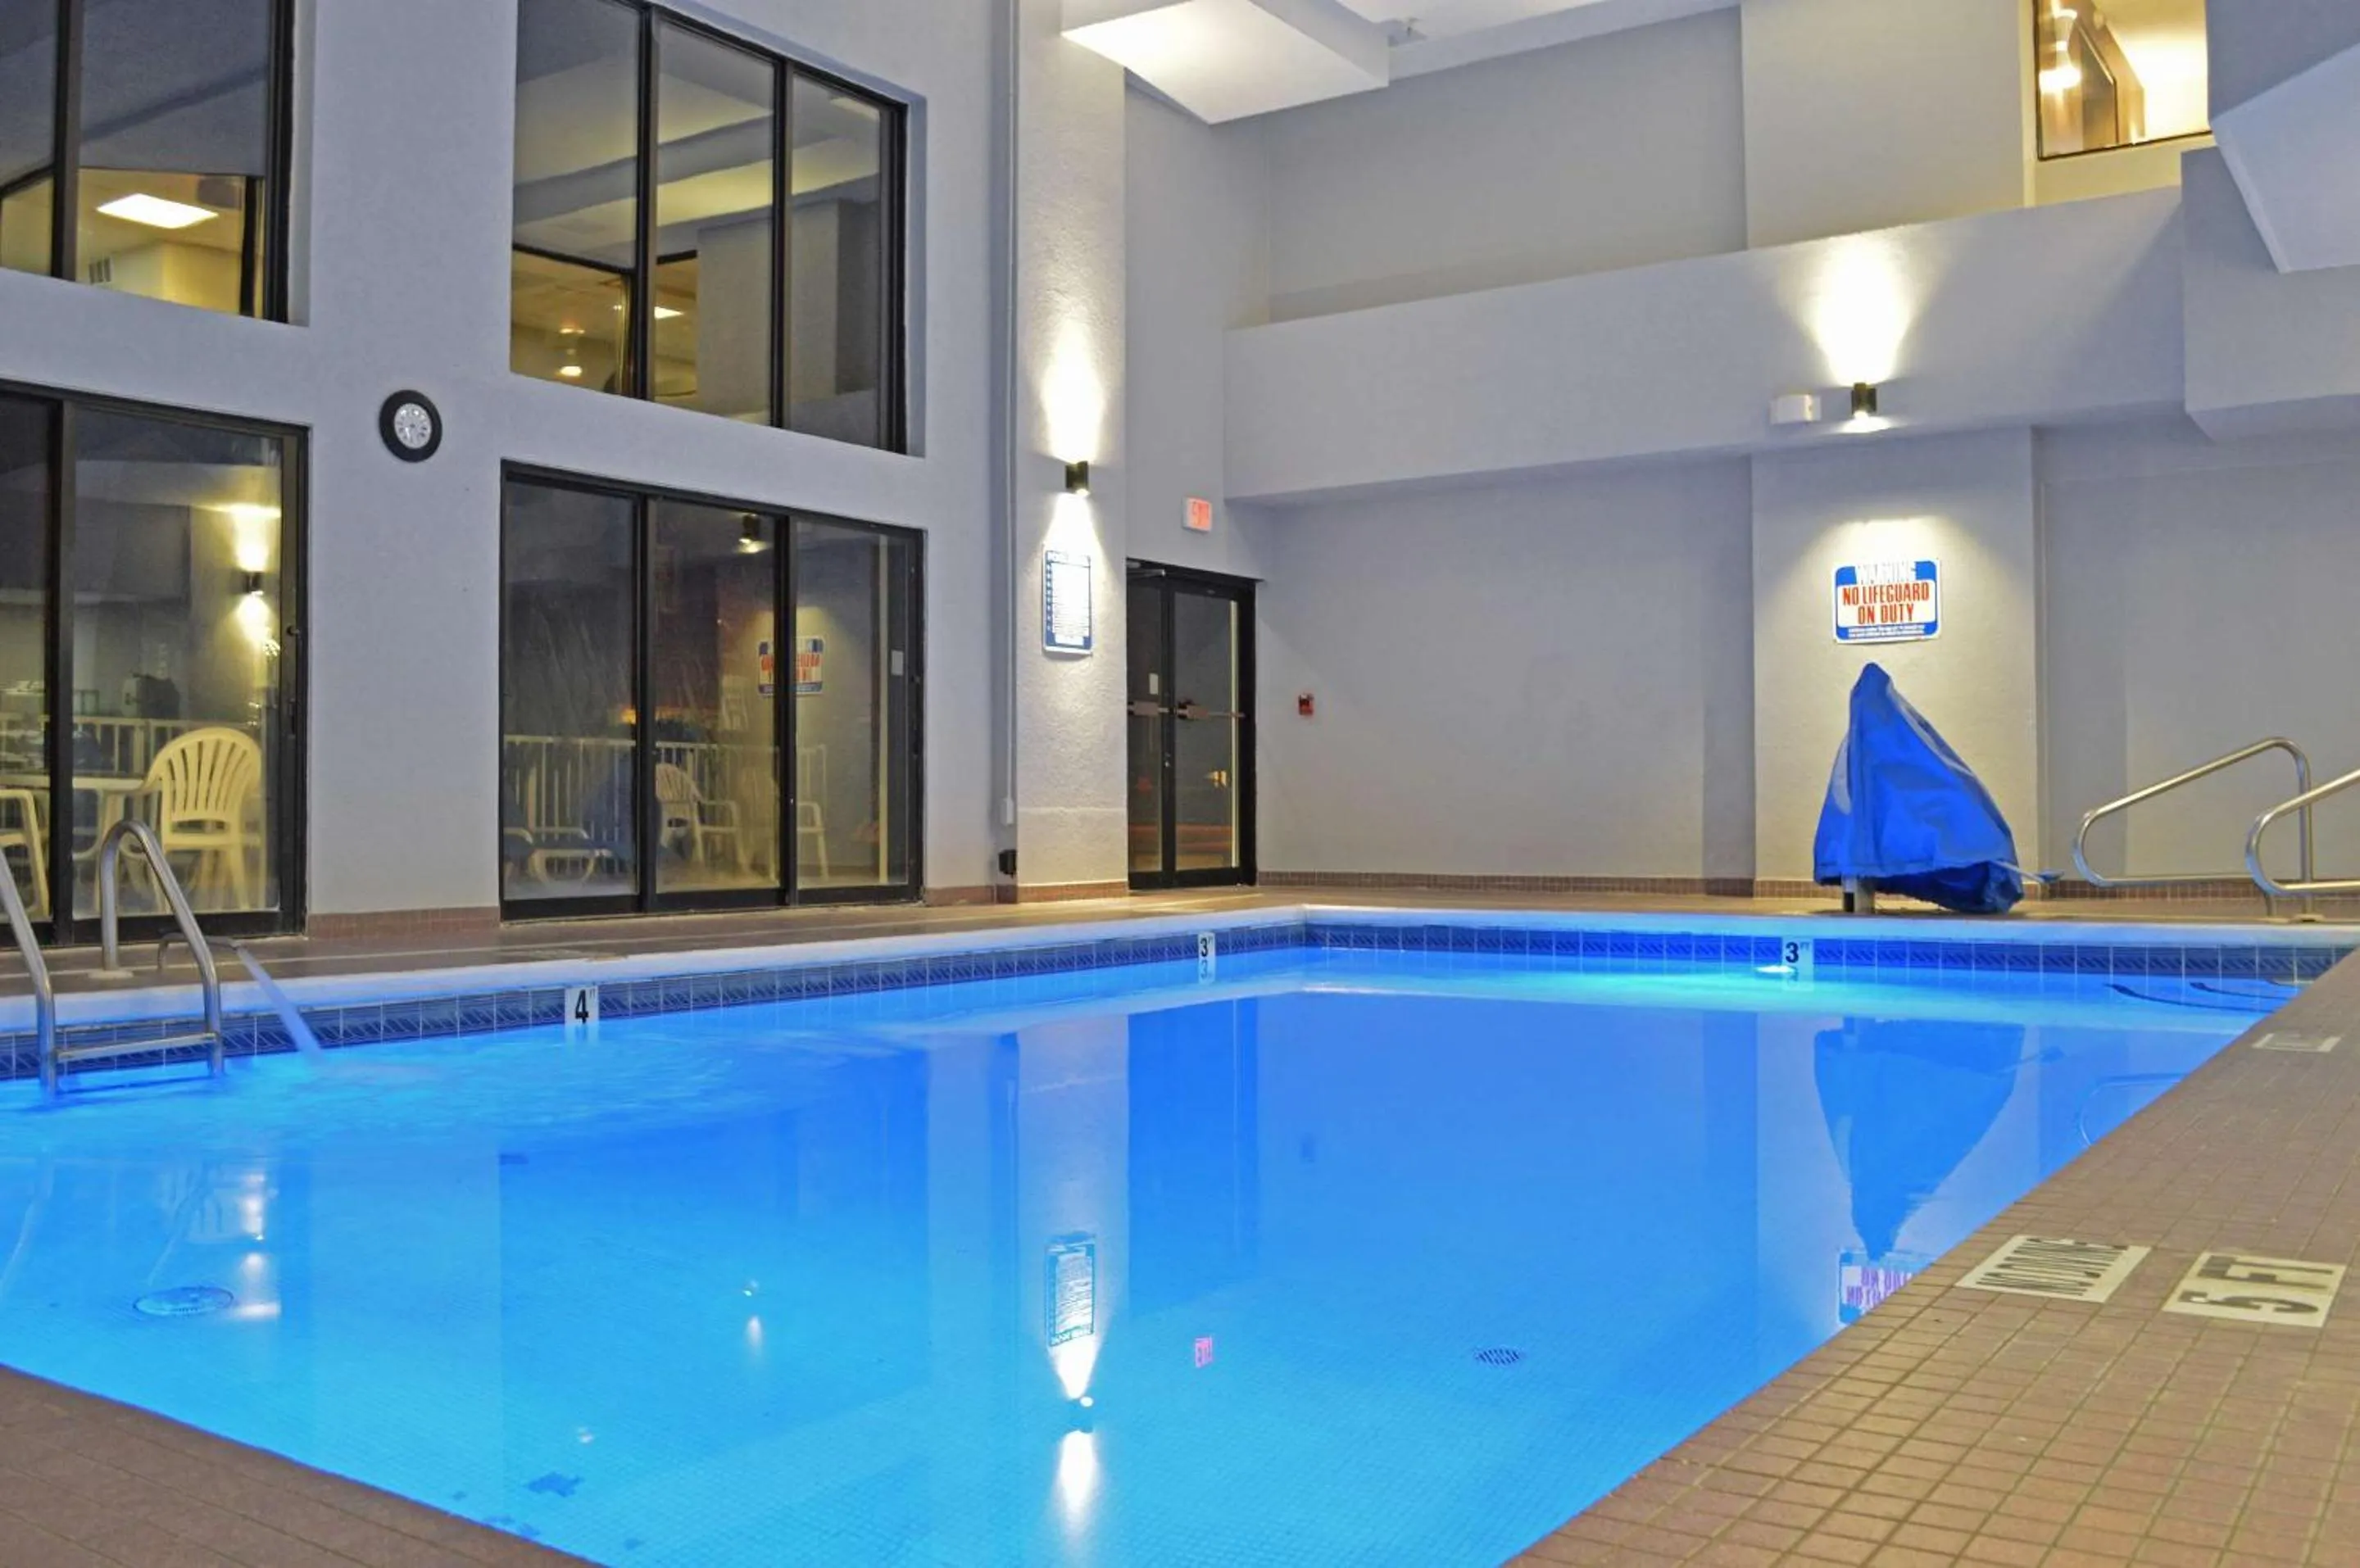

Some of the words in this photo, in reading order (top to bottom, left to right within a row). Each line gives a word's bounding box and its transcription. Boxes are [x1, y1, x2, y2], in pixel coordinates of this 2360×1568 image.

[1842, 586, 1859, 605] NO
[1862, 582, 1930, 605] LIFEGUARD
[1858, 605, 1875, 624] ON
[1881, 603, 1914, 623] DUTY
[1200, 937, 1209, 957] 3
[1786, 941, 1799, 963] 3
[575, 989, 589, 1023] 4
[2197, 1254, 2335, 1289] FT
[2177, 1290, 2319, 1314] 5
